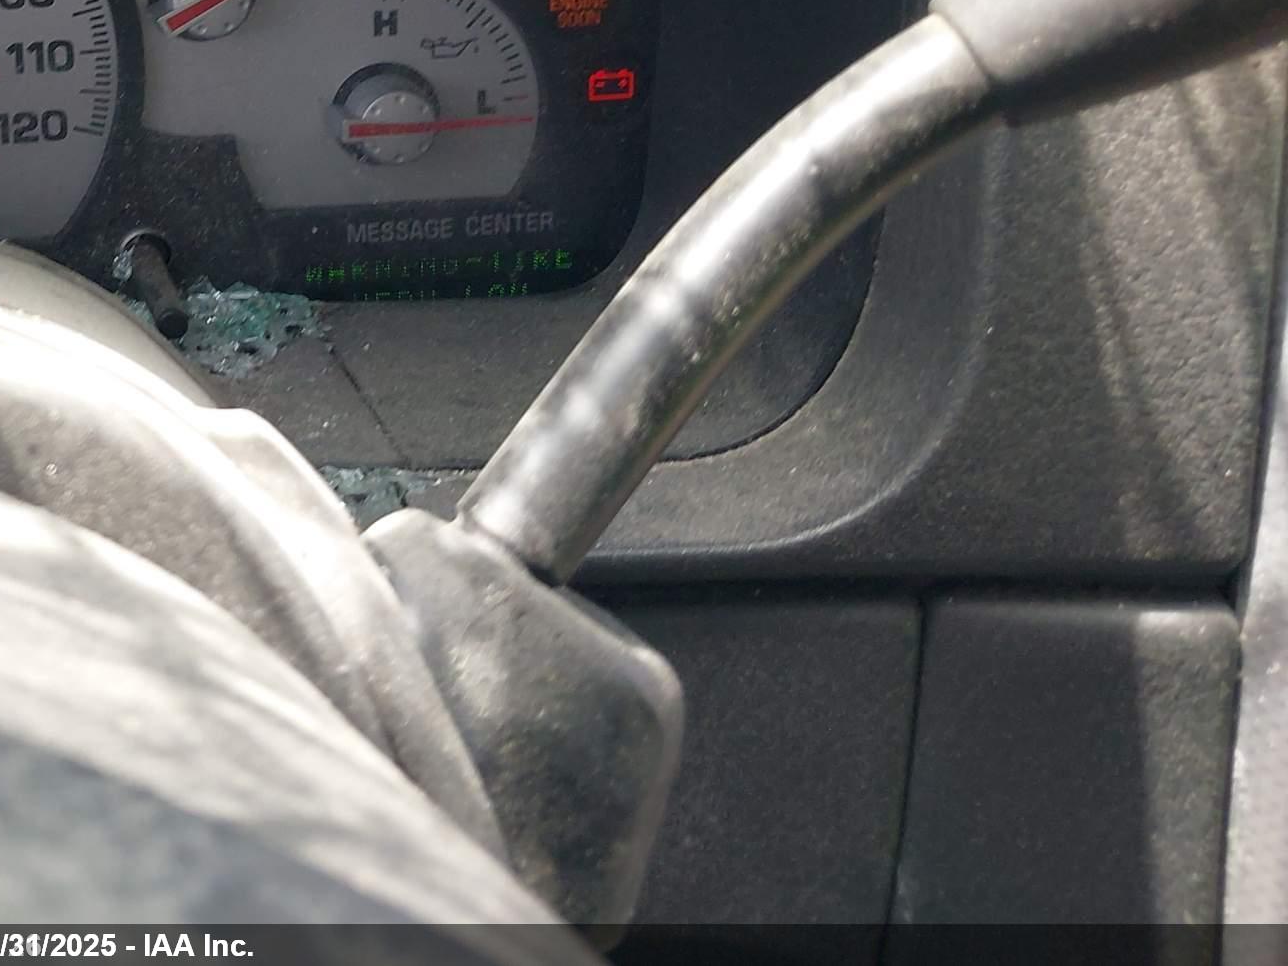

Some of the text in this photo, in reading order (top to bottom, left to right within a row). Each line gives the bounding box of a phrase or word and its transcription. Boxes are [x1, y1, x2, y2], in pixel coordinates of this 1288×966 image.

[373, 10, 398, 37] H
[558, 10, 601, 27] SOON
[6, 40, 75, 75] 110
[477, 90, 497, 116] L
[346, 212, 554, 243] MESSAGE CENTER
